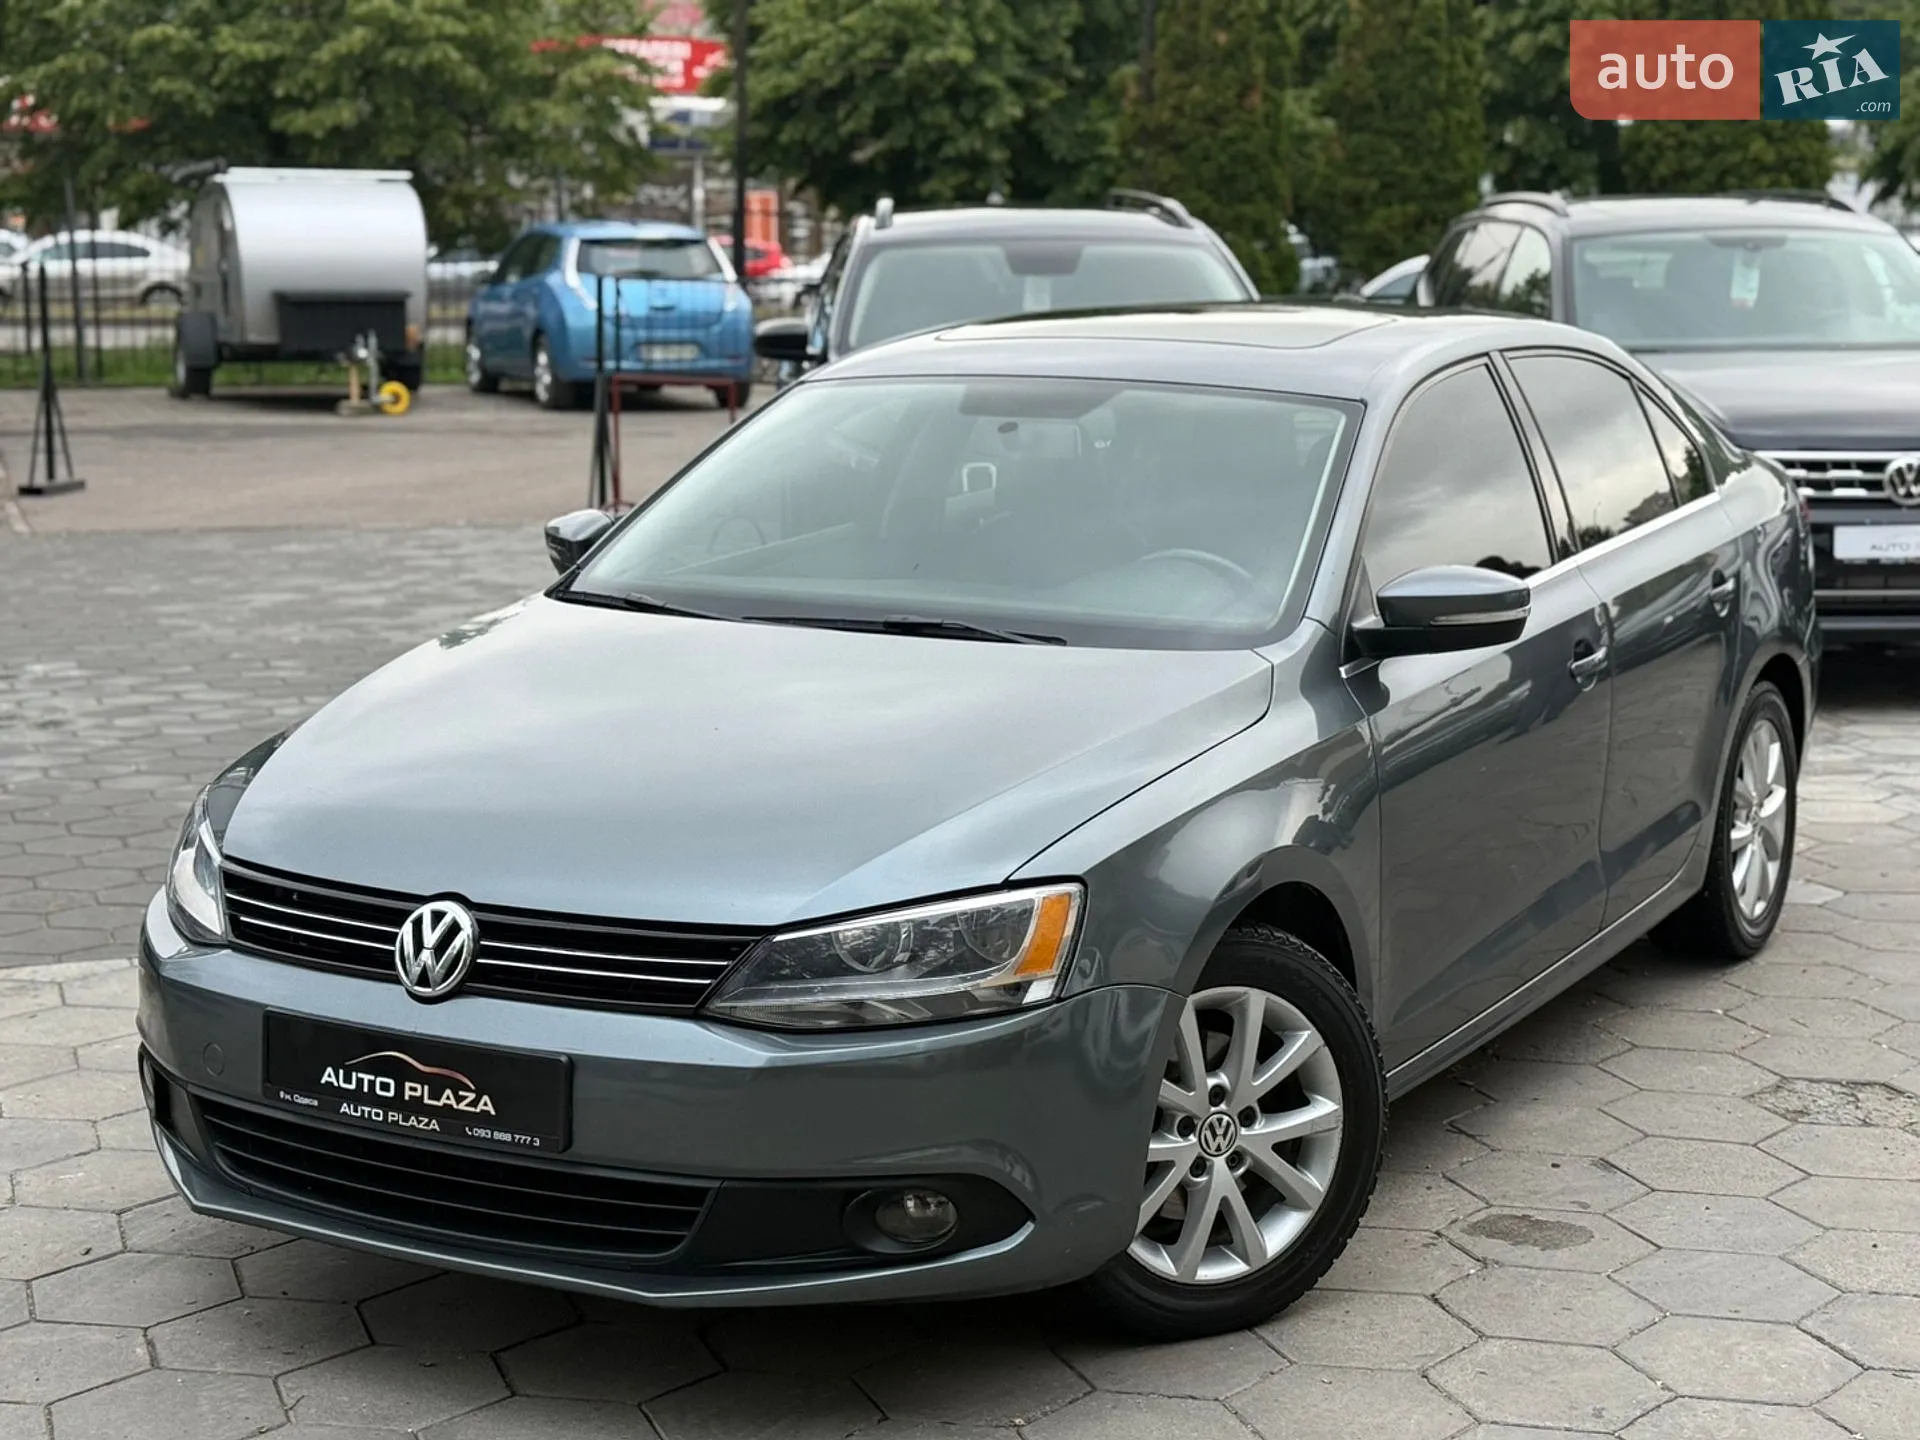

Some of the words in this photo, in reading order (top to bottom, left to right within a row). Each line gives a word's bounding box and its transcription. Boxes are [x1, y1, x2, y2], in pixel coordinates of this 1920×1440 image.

[1869, 542, 1911, 552] AUTO
[320, 1066, 395, 1098] AUTO
[404, 1081, 496, 1116] PLAZA
[339, 1102, 384, 1121] AUTO
[387, 1111, 440, 1132] PLAZA
[473, 1127, 491, 1139] 093
[513, 1134, 532, 1145] 777
[533, 1137, 540, 1147] 3
